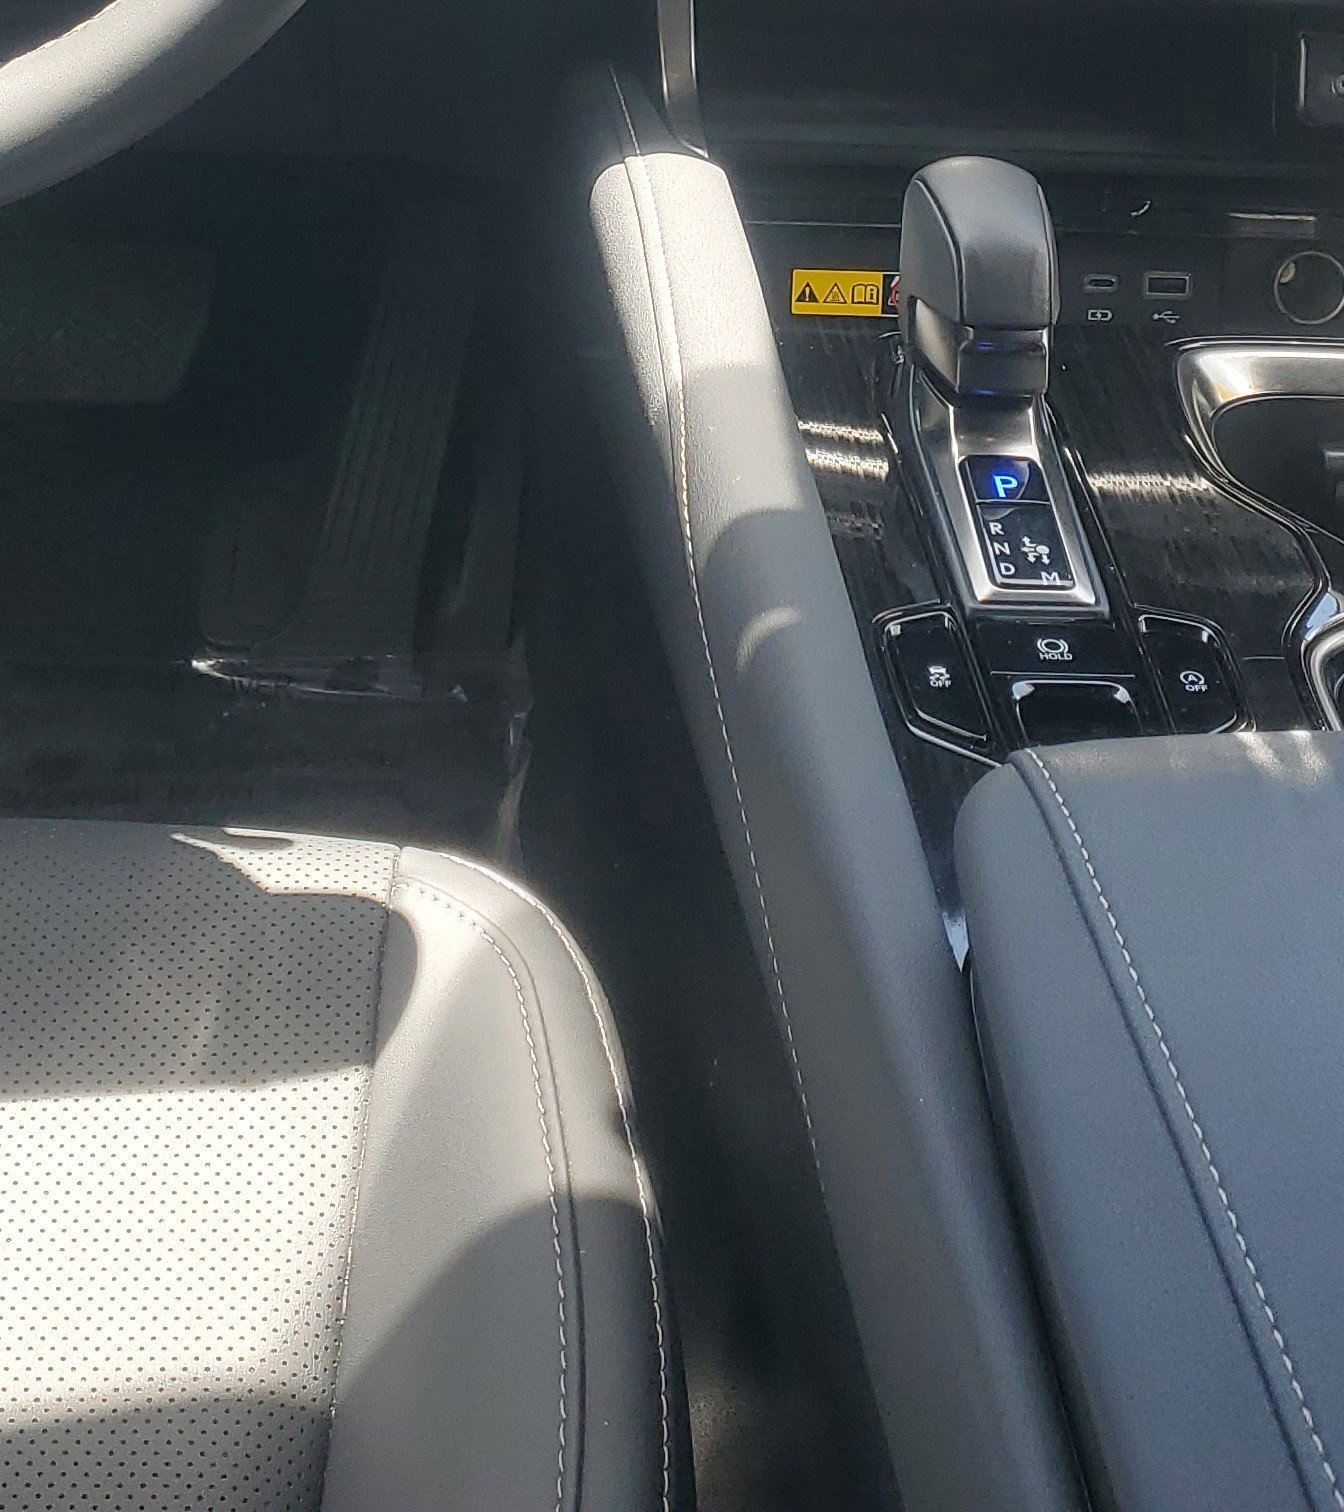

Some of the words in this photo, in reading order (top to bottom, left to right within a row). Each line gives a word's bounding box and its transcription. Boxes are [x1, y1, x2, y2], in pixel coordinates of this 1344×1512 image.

[992, 474, 1018, 499] P
[989, 521, 1004, 536] R
[994, 540, 1012, 557] N
[1000, 561, 1016, 577] D
[1040, 570, 1061, 586] M
[1039, 651, 1073, 661] HOLD
[929, 679, 951, 689] OFF
[1185, 684, 1208, 692] OFF
